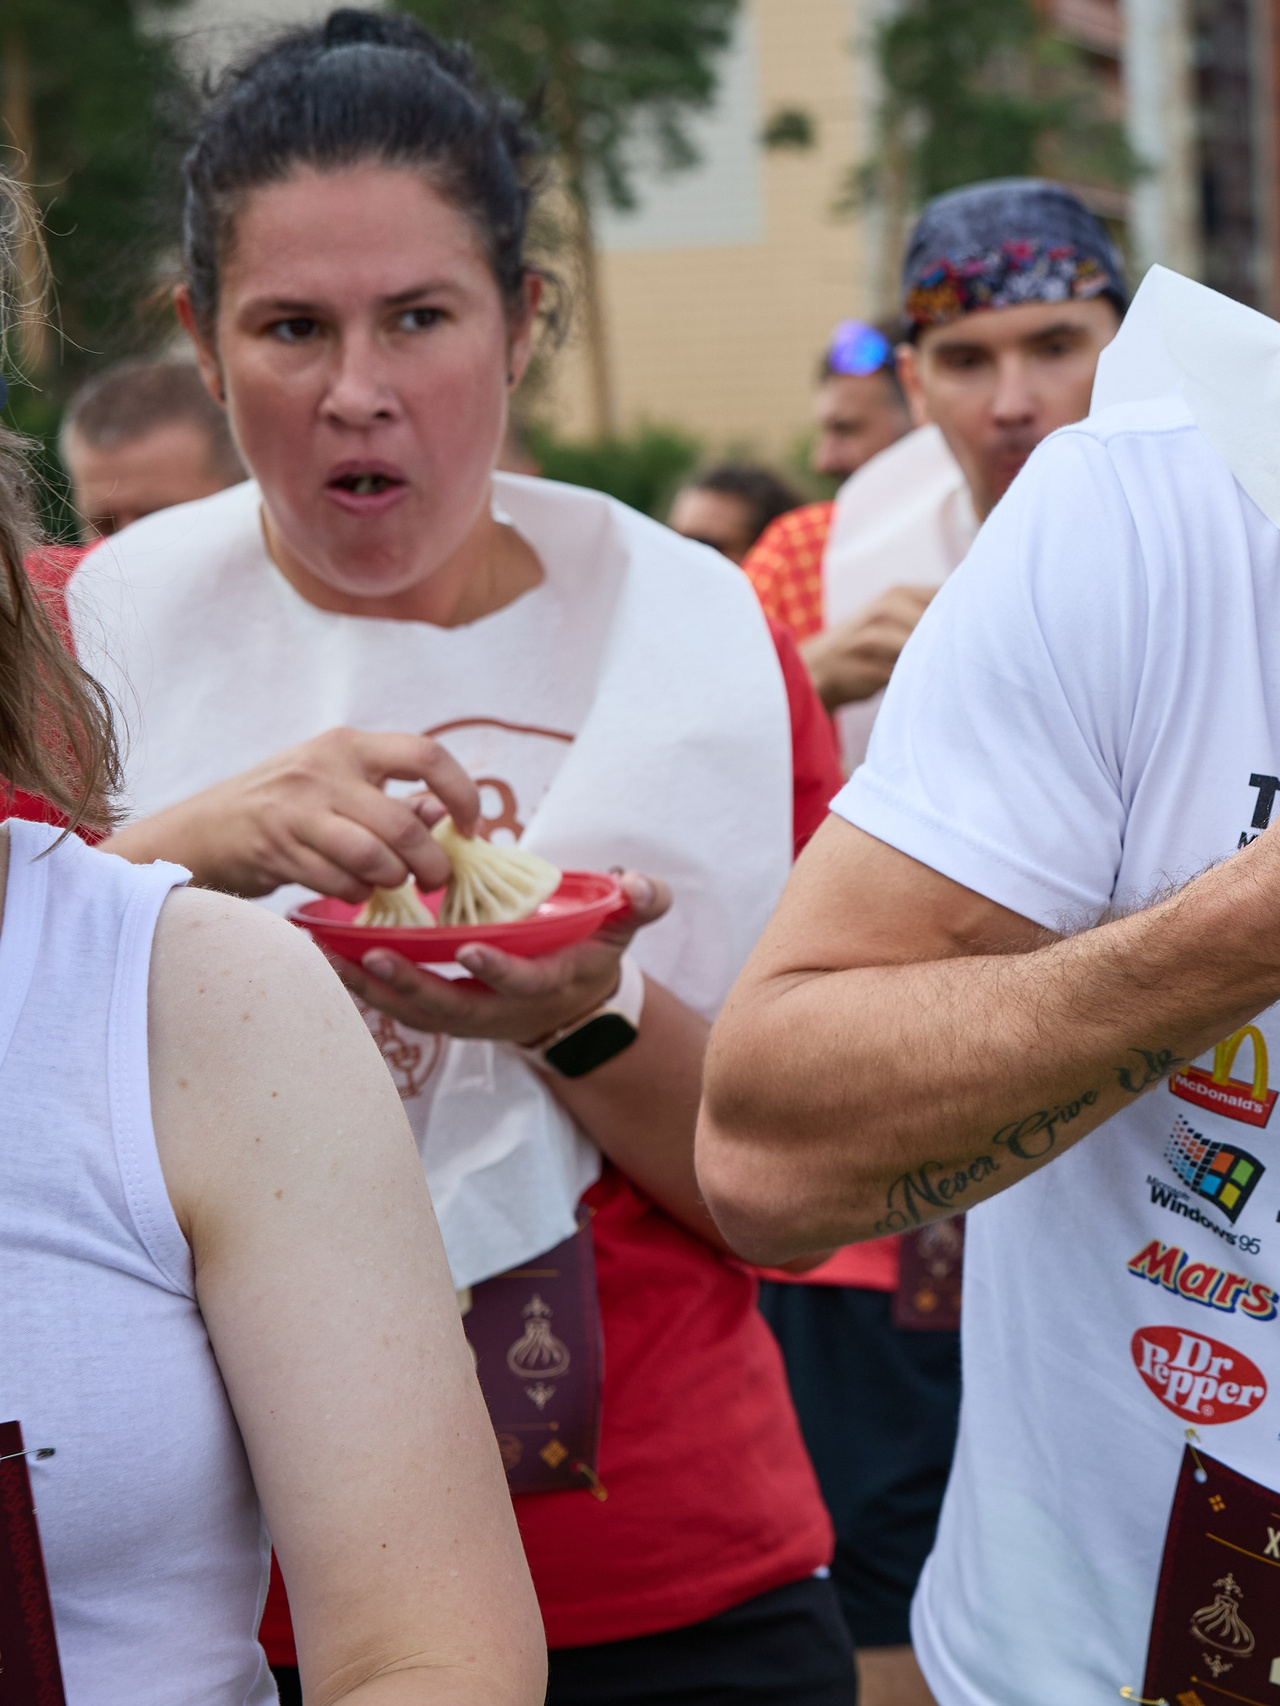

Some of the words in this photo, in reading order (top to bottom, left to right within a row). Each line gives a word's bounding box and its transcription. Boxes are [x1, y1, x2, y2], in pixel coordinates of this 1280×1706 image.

[1175, 1074, 1264, 1114] McDonald's
[878, 1155, 1001, 1231] Never
[992, 1088, 1100, 1160] Give
[1146, 1174, 1191, 1202] Microsoft
[1150, 1184, 1238, 1247] Windows
[1238, 1234, 1261, 1255] 95
[1127, 1238, 1279, 1321] Mars
[1138, 1337, 1265, 1415] Pepper
[1168, 1332, 1234, 1379] Dr
